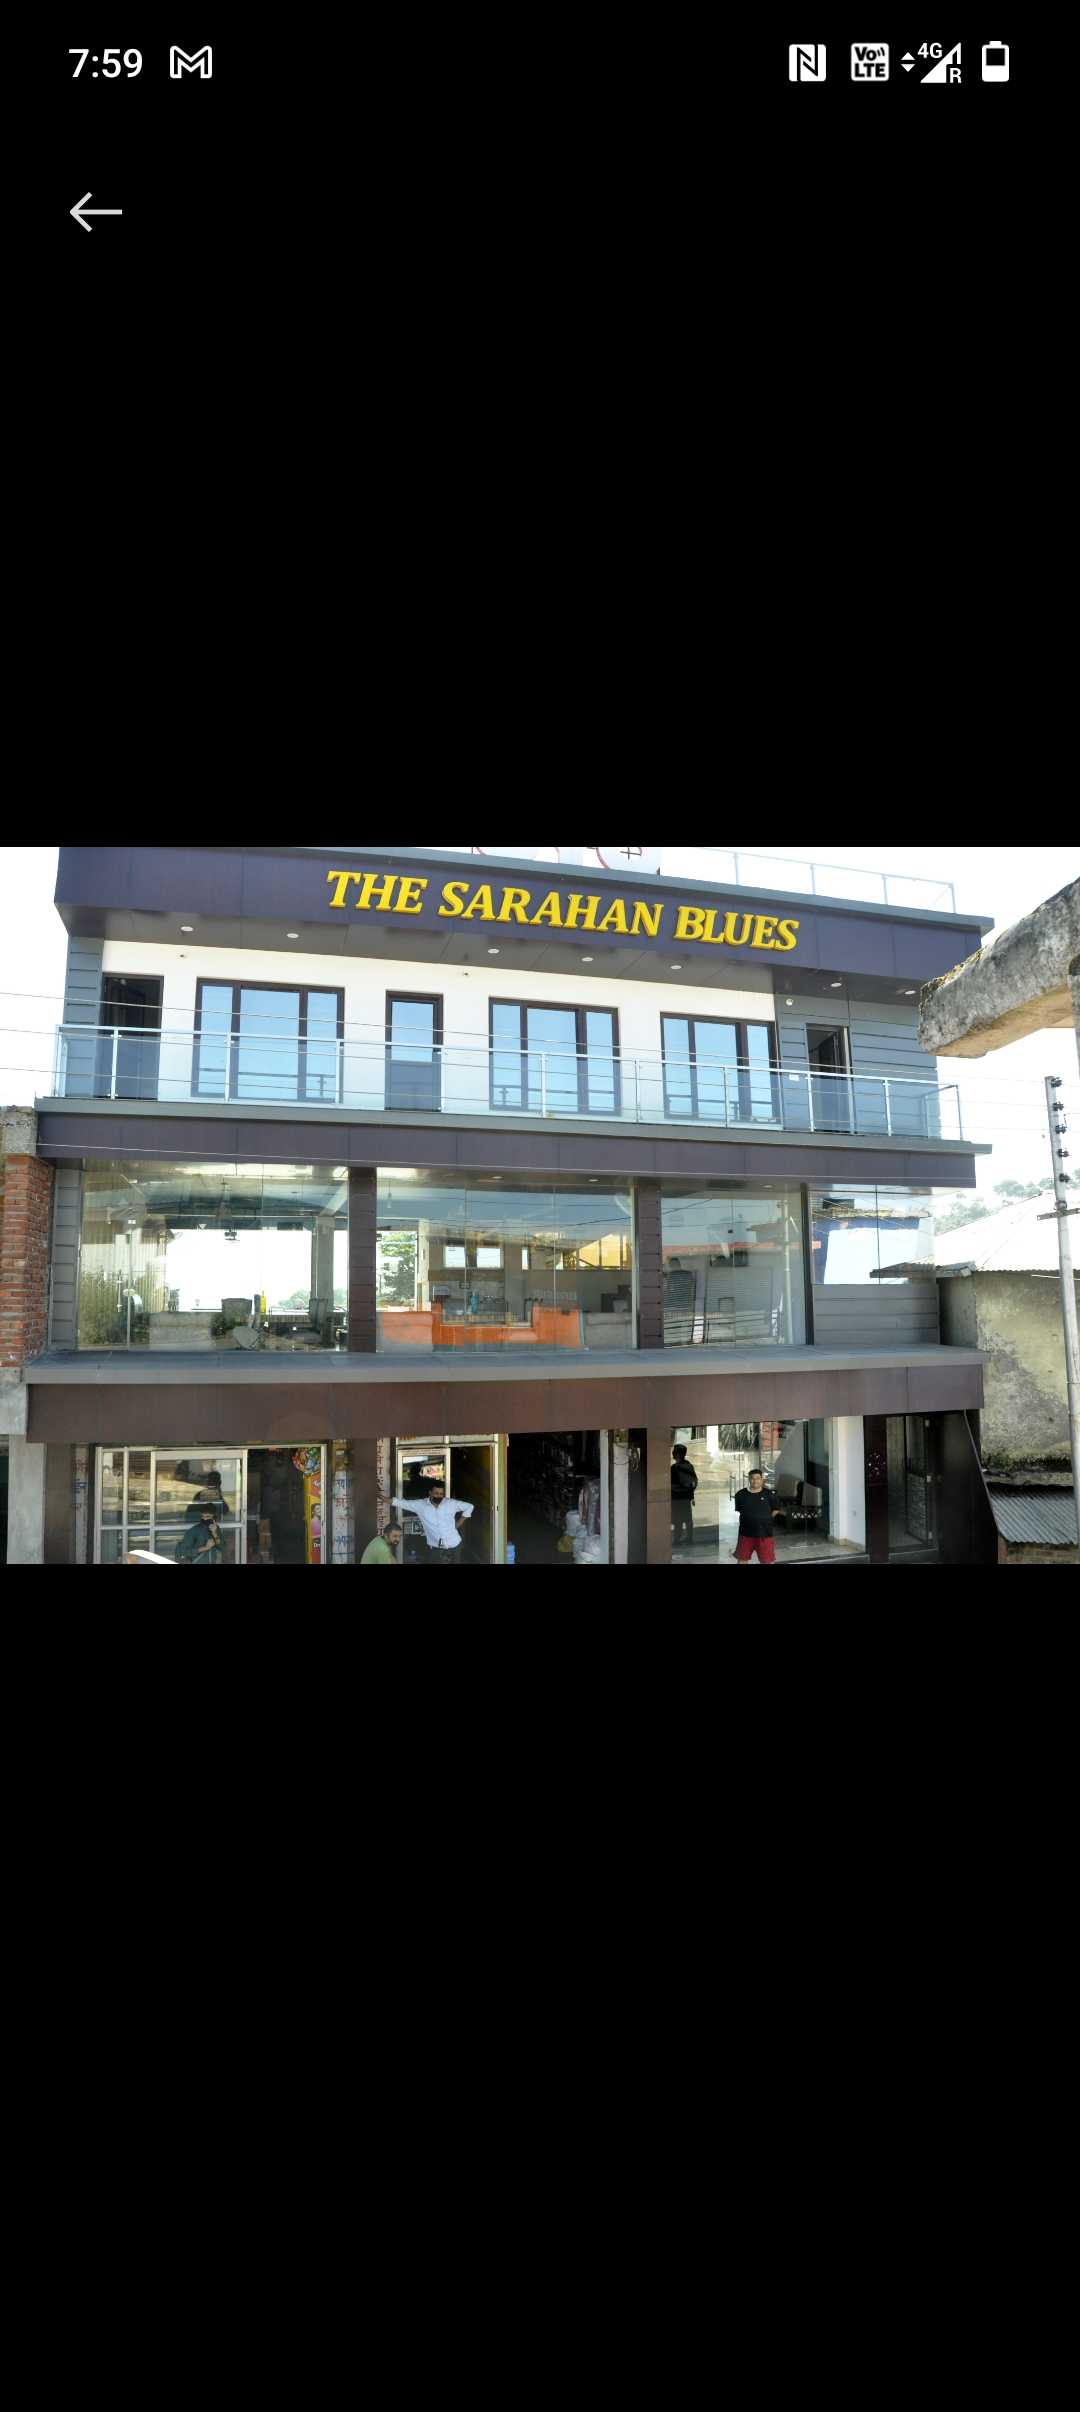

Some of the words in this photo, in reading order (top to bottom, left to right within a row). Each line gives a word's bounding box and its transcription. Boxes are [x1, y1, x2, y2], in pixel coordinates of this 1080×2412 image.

[326, 870, 428, 914] THE
[438, 881, 664, 938] SARAHAN
[674, 907, 800, 951] BLUES
